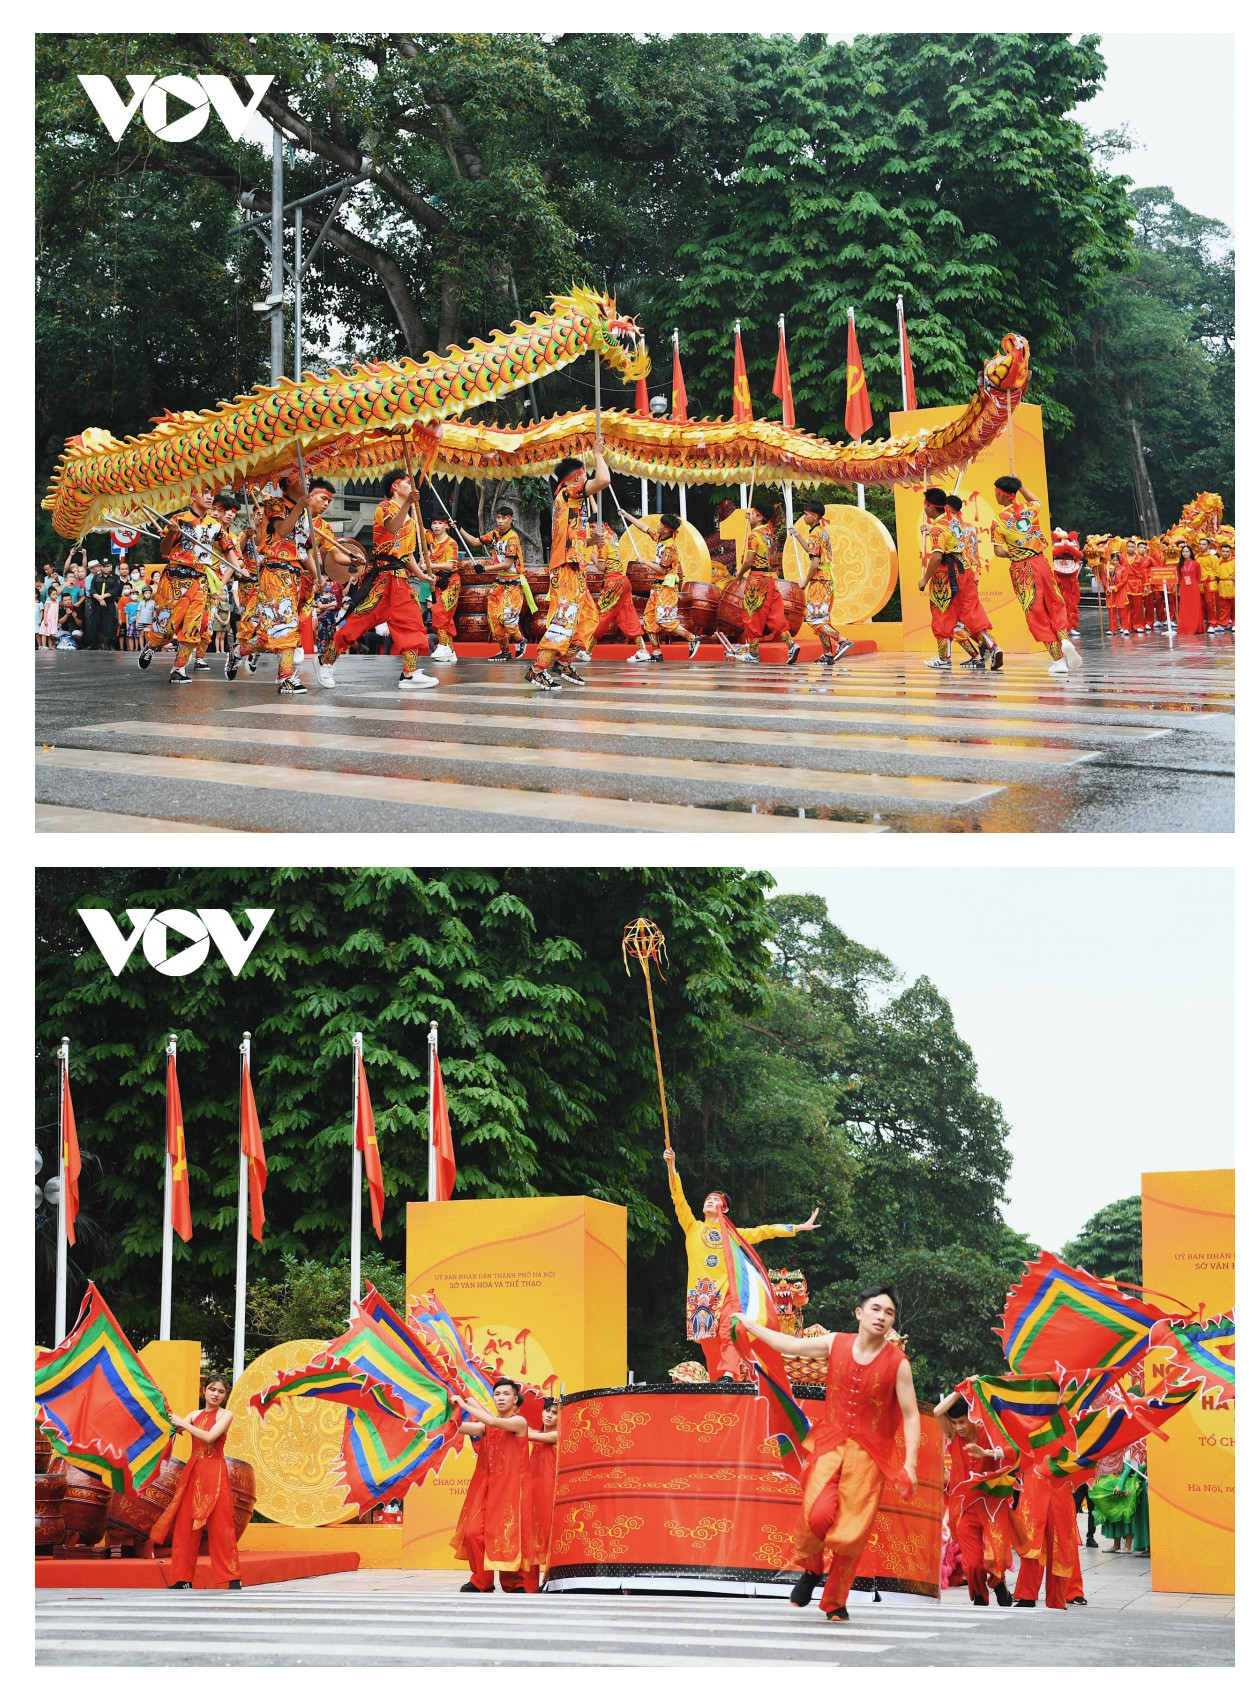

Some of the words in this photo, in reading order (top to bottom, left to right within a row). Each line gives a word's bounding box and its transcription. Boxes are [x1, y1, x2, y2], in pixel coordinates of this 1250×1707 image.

[1206, 1252, 1232, 1260] NHÂN
[1210, 1261, 1229, 1270] VĂN
[517, 1270, 532, 1278] PHỐ
[543, 1270, 556, 1278] NỘI
[449, 1281, 460, 1289] SỞ
[460, 1281, 476, 1289] VĂN
[477, 1280, 493, 1288] HOÁ
[494, 1280, 503, 1288] VÀ
[504, 1278, 520, 1287] THỂ
[1198, 1433, 1217, 1447] TỔ
[432, 1478, 455, 1486] CHÀO
[1188, 1484, 1201, 1492] Hà
